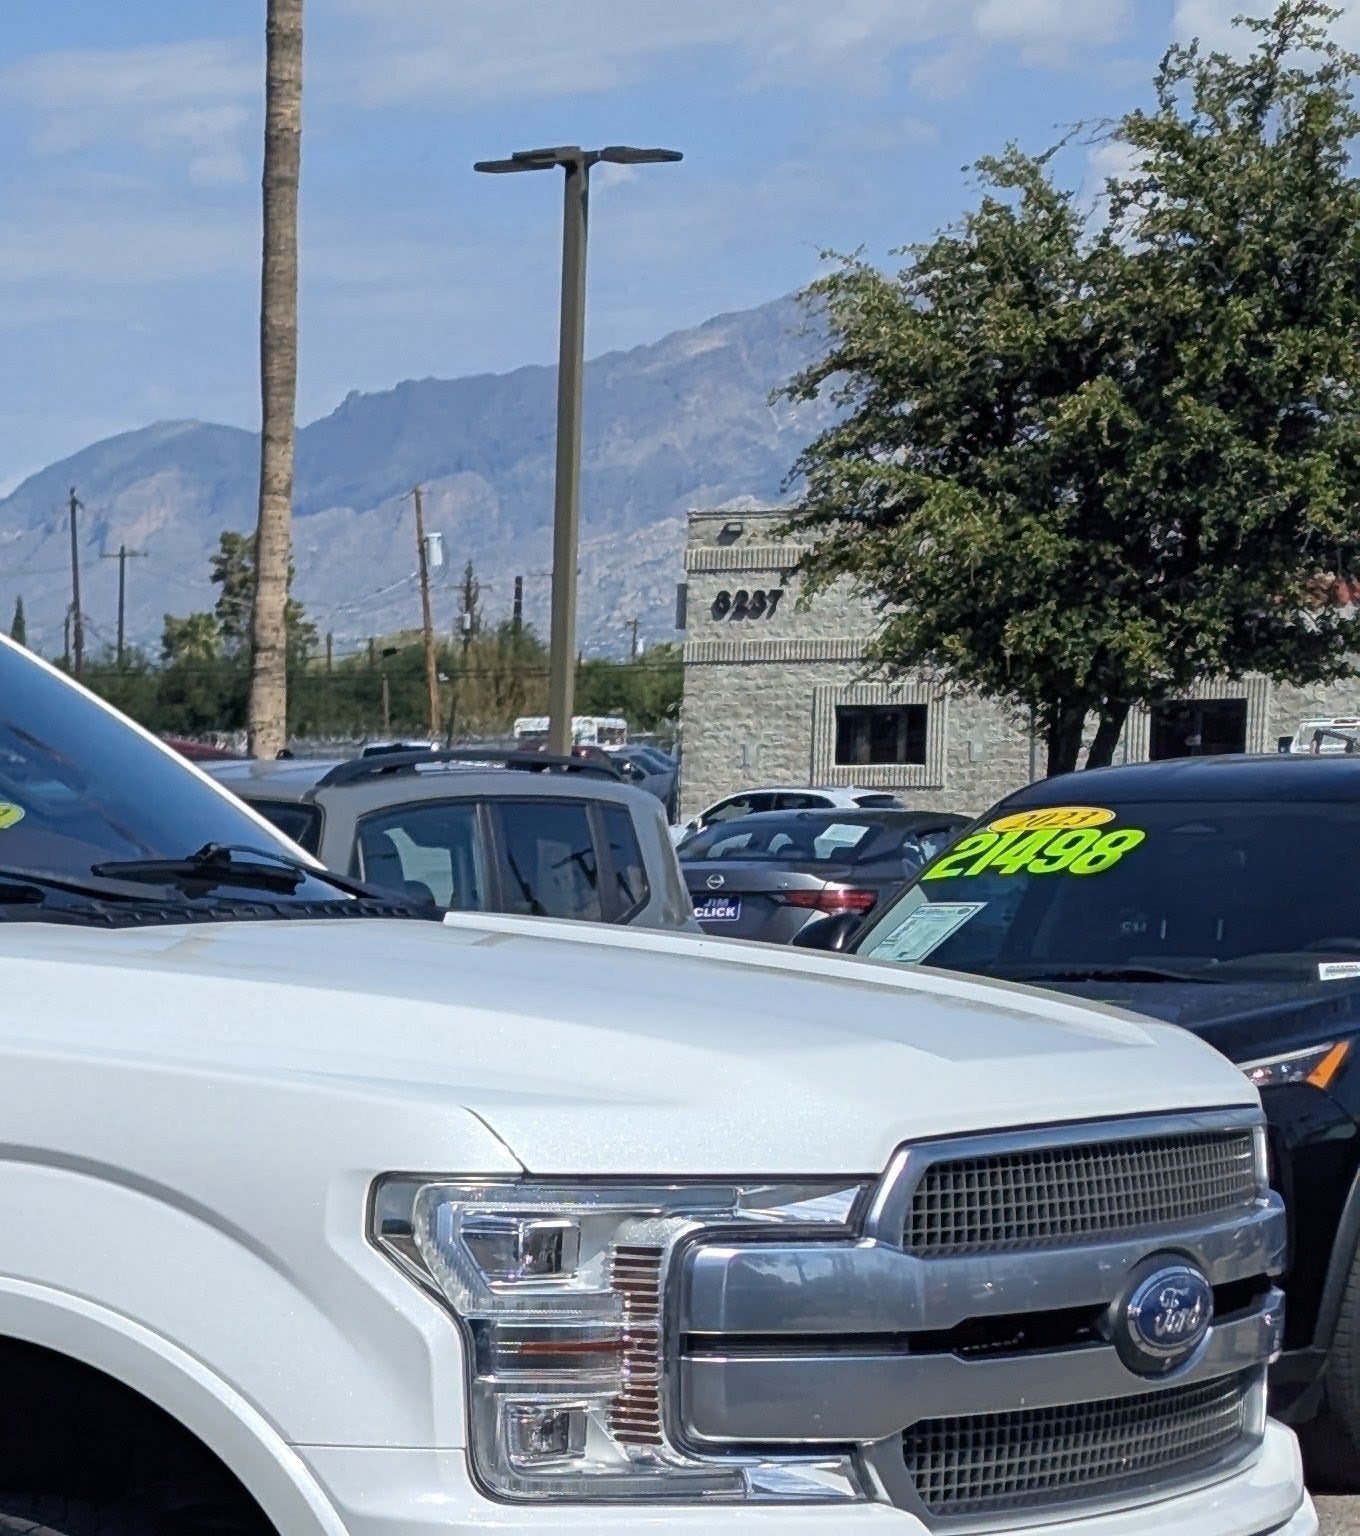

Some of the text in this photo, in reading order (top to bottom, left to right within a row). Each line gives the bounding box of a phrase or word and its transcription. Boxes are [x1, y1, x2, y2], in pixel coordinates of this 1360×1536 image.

[1003, 810, 1100, 831] 2023
[920, 828, 1147, 881] 21498
[703, 897, 730, 908] JIM
[693, 906, 736, 918] CLICK
